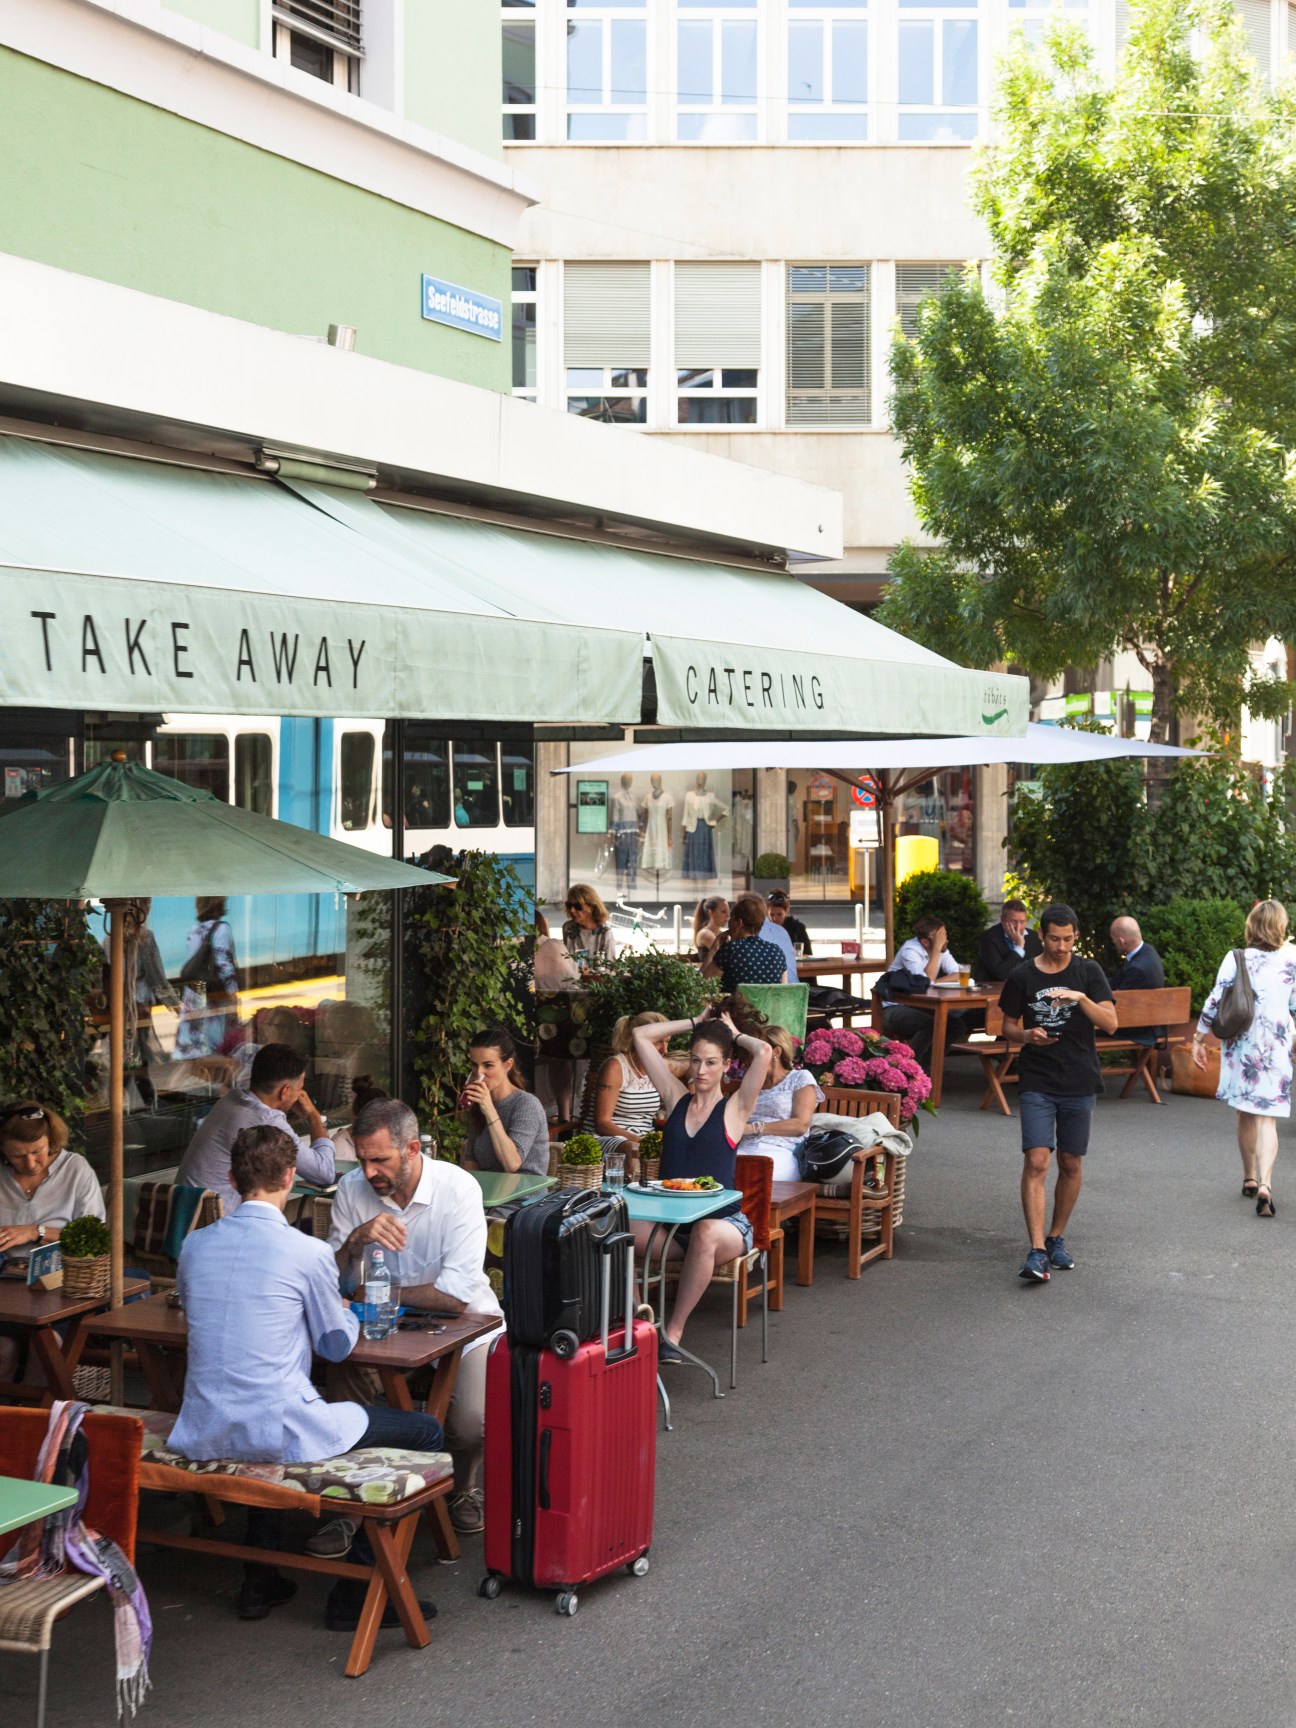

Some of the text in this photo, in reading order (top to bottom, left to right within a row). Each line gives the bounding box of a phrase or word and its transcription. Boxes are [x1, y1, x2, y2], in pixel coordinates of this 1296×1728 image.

[427, 285, 499, 330] Seefeldstrasse
[30, 610, 366, 690] TAKE AWAY
[686, 665, 825, 710] CATERING
